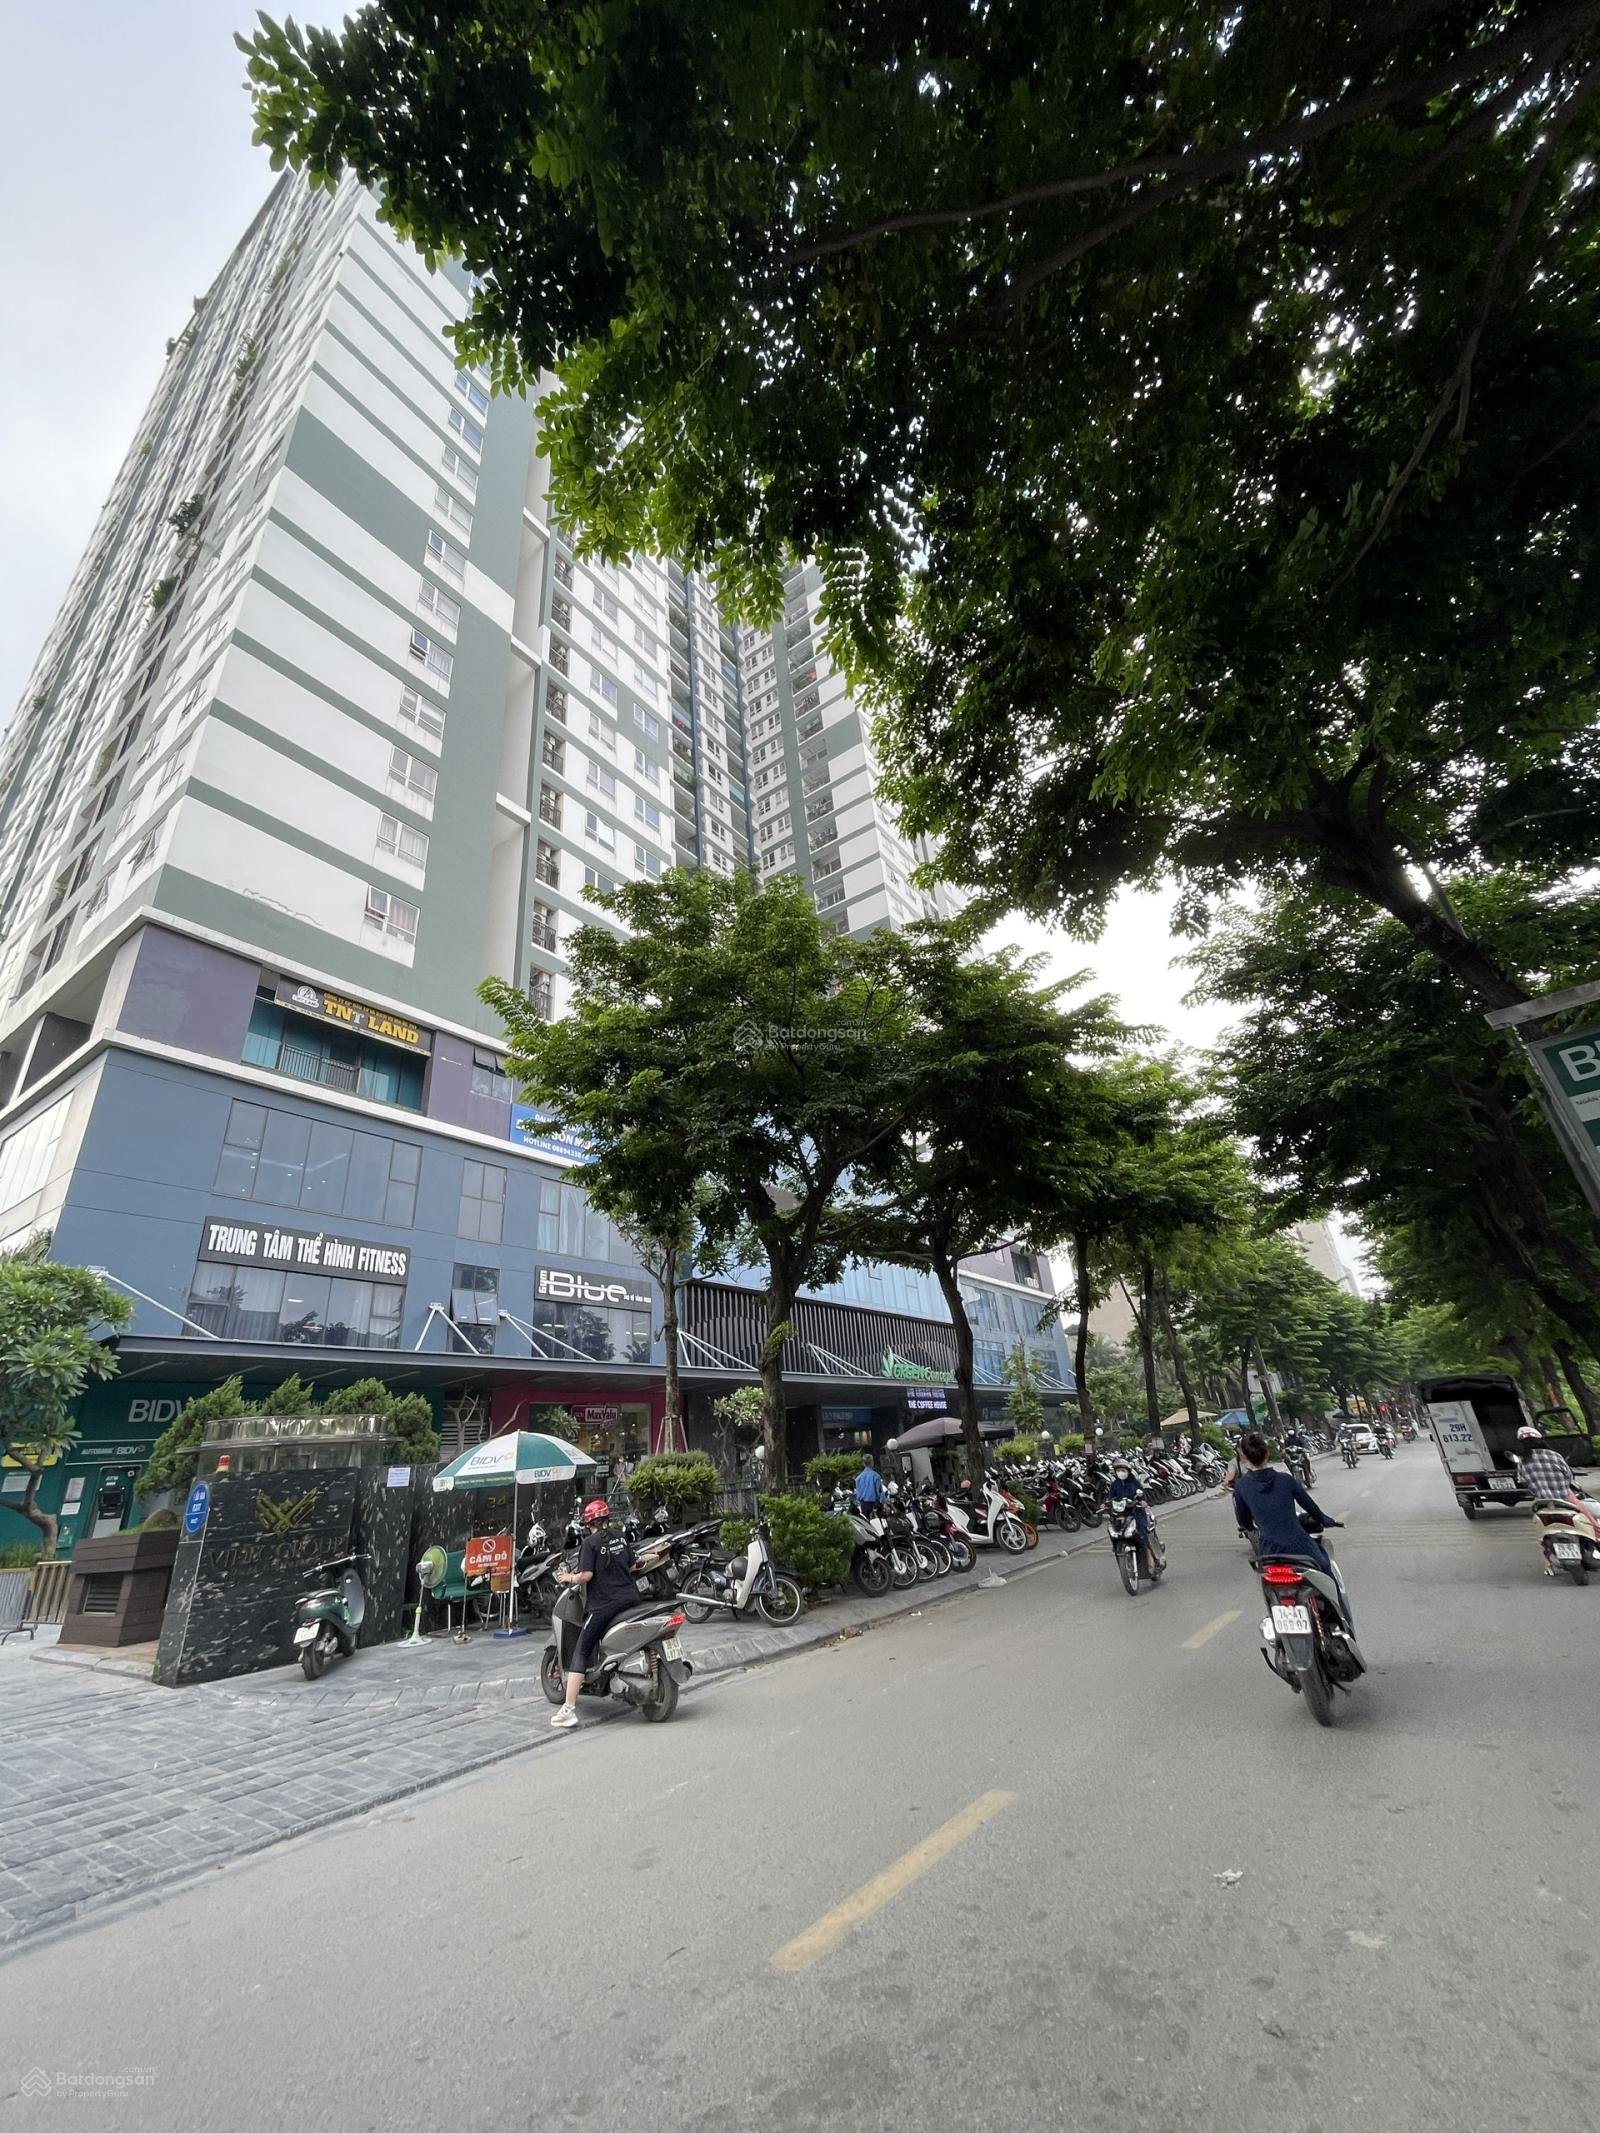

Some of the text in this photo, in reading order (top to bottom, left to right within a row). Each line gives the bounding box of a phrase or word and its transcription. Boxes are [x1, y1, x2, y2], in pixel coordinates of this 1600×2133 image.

[324, 1000, 365, 1024] TNT
[367, 1016, 419, 1044] LAND
[1558, 1041, 1600, 1082] B
[523, 1135, 551, 1150] HOTLINE
[208, 1224, 407, 1276] TRUNG TÂM THỂ HÌNH FITNESS
[548, 1271, 627, 1302] Blue
[917, 1400, 934, 1409] COFFEE
[1449, 1423, 1467, 1432] 29H
[1442, 1433, 1473, 1443] 613.22
[116, 1446, 137, 1455] BIDV
[470, 1455, 503, 1466] BIDV
[534, 1469, 552, 1478] BIDV
